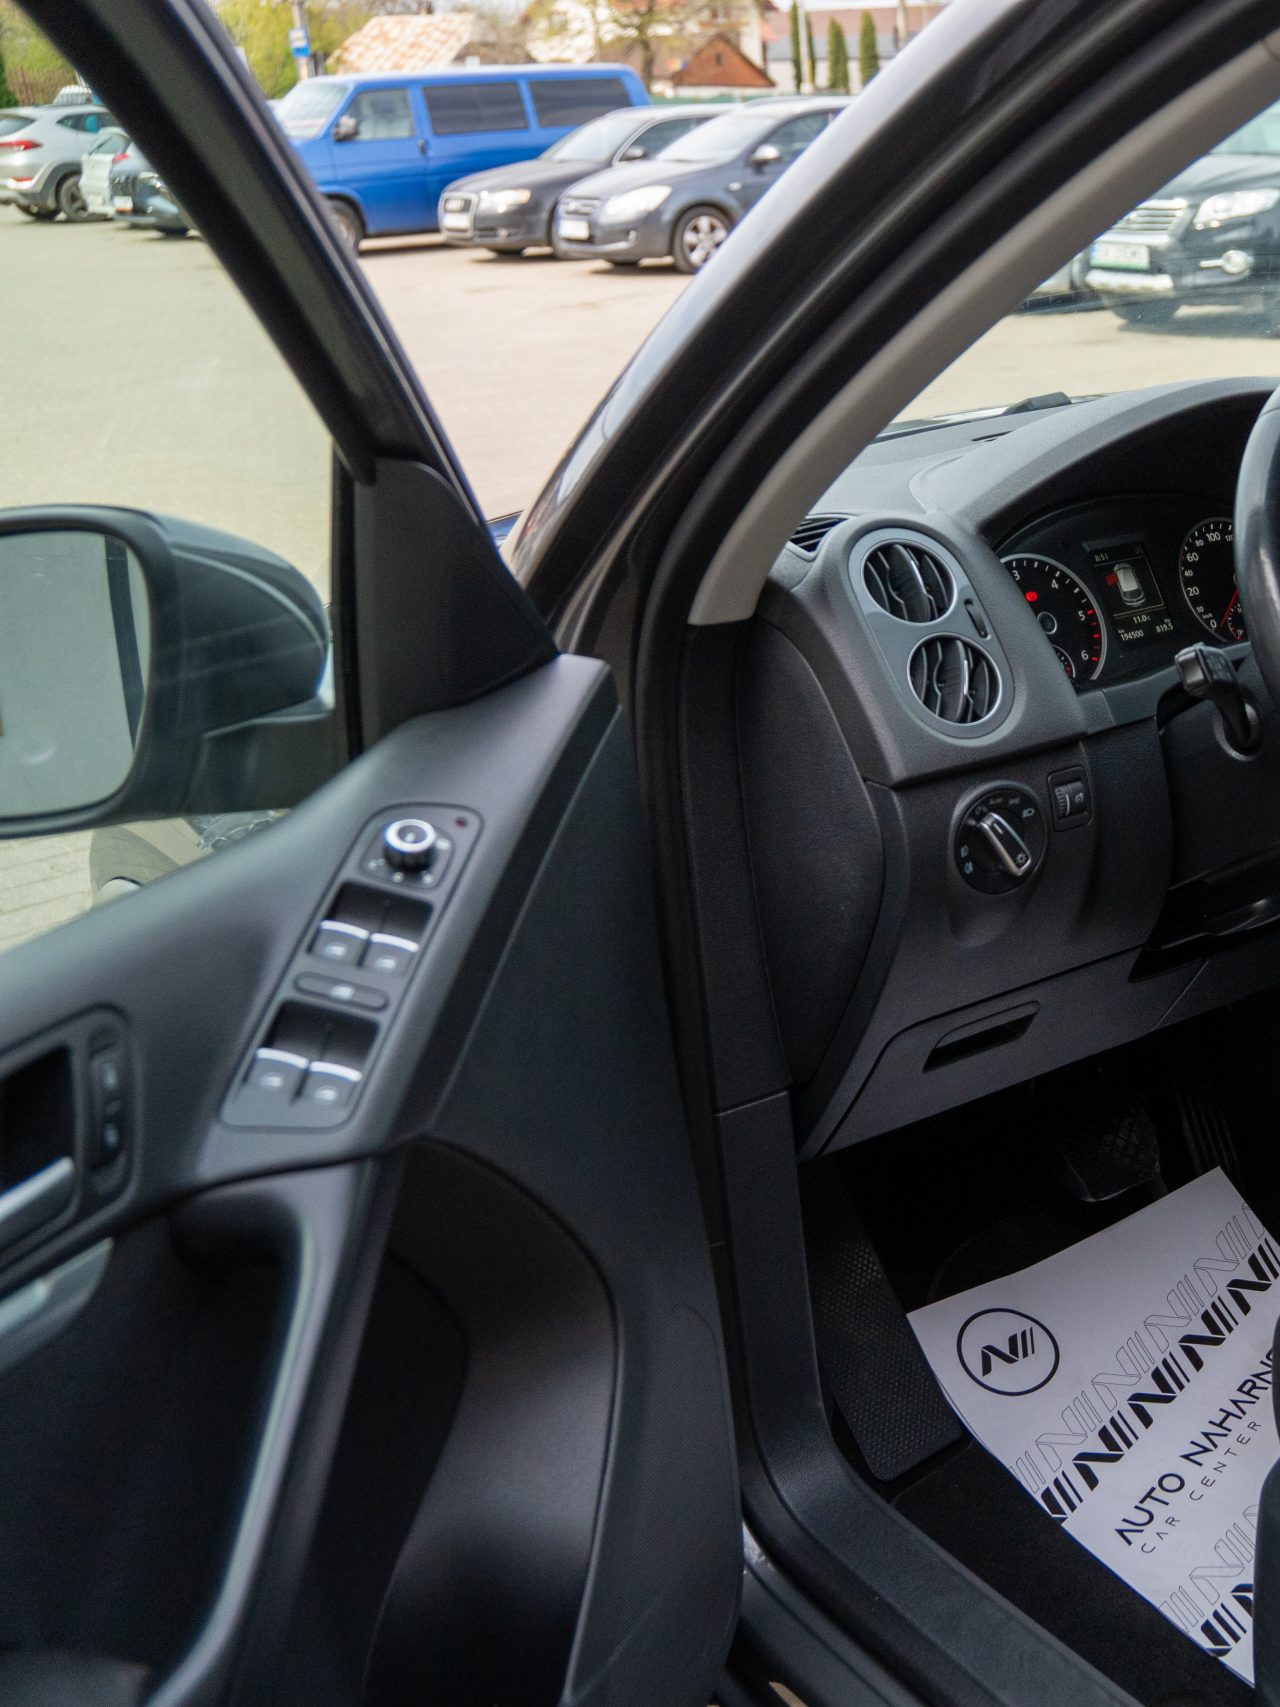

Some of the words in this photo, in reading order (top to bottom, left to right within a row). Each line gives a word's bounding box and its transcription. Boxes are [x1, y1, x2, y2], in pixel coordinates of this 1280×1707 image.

[1206, 531, 1221, 542] 100
[1195, 539, 1204, 547] 80
[1186, 552, 1199, 562] 60
[1012, 569, 1020, 581] 3
[1184, 569, 1194, 577] 40
[1051, 579, 1059, 590] 4
[1187, 586, 1200, 597] 20
[1196, 605, 1204, 613] 10
[1078, 610, 1086, 622] 5
[1155, 622, 1174, 633] 819.5
[1209, 619, 1217, 629] 0
[1081, 649, 1089, 661] 6
[1141, 1516, 1181, 1554] CAR
[1189, 1421, 1262, 1501] CENTER
[1114, 1472, 1186, 1547] AUTO
